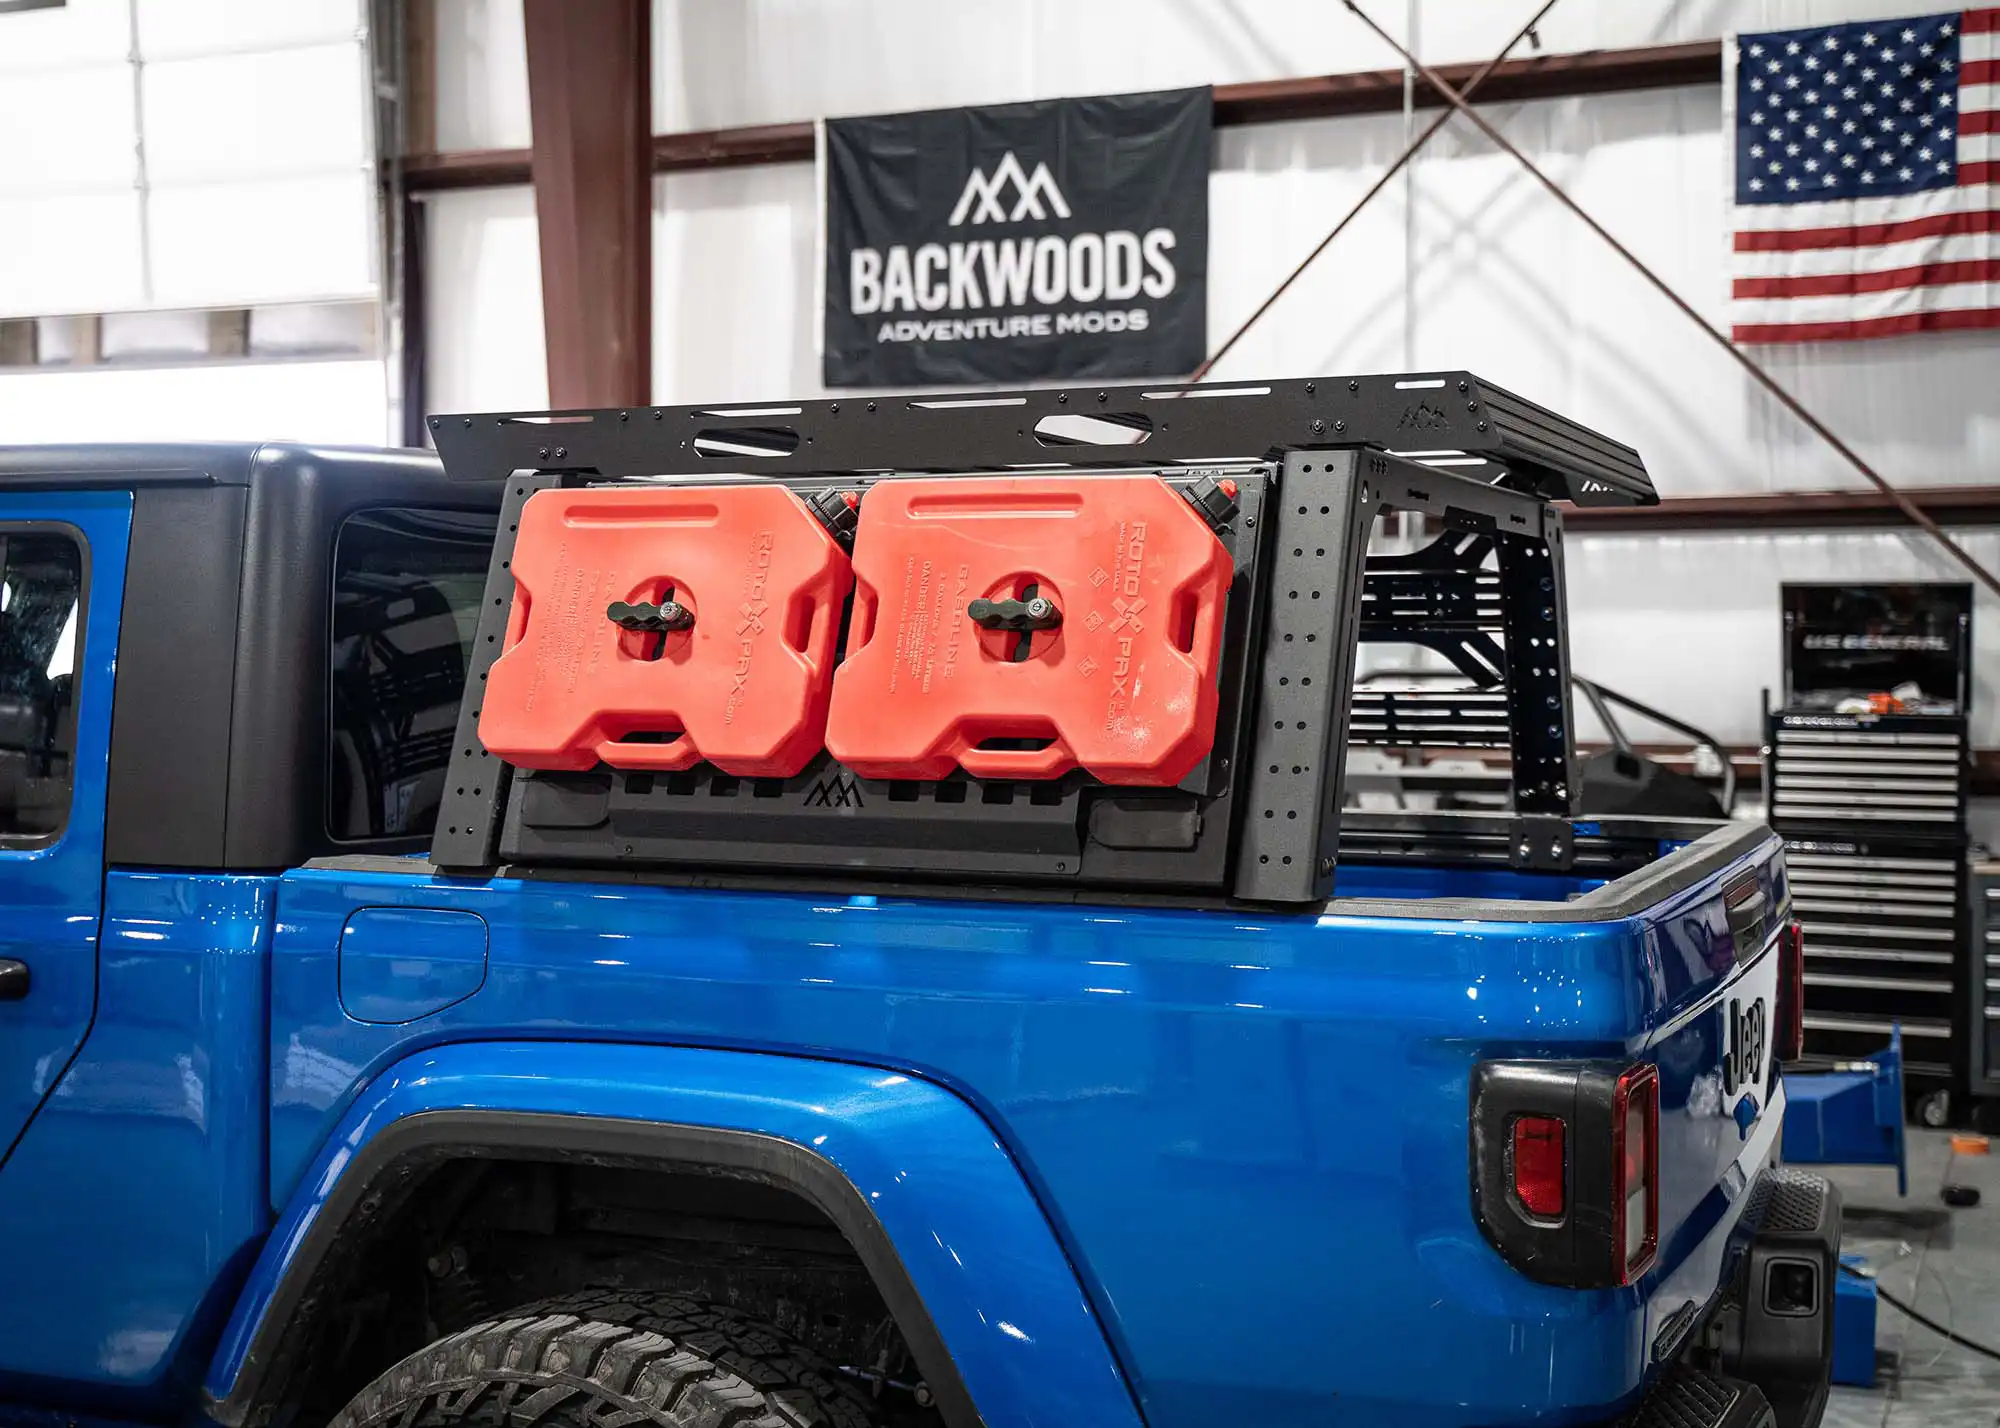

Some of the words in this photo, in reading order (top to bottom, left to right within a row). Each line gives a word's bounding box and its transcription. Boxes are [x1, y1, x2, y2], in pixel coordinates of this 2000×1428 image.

[850, 227, 1176, 315] BACKWOODS
[877, 314, 1051, 344] ADVENTURE
[1055, 309, 1149, 334] MODS
[587, 569, 617, 678] GAOLINE
[943, 563, 969, 680] GASOLINE
[1110, 637, 1134, 699] PAX
[1723, 996, 1766, 1095] Jeep
